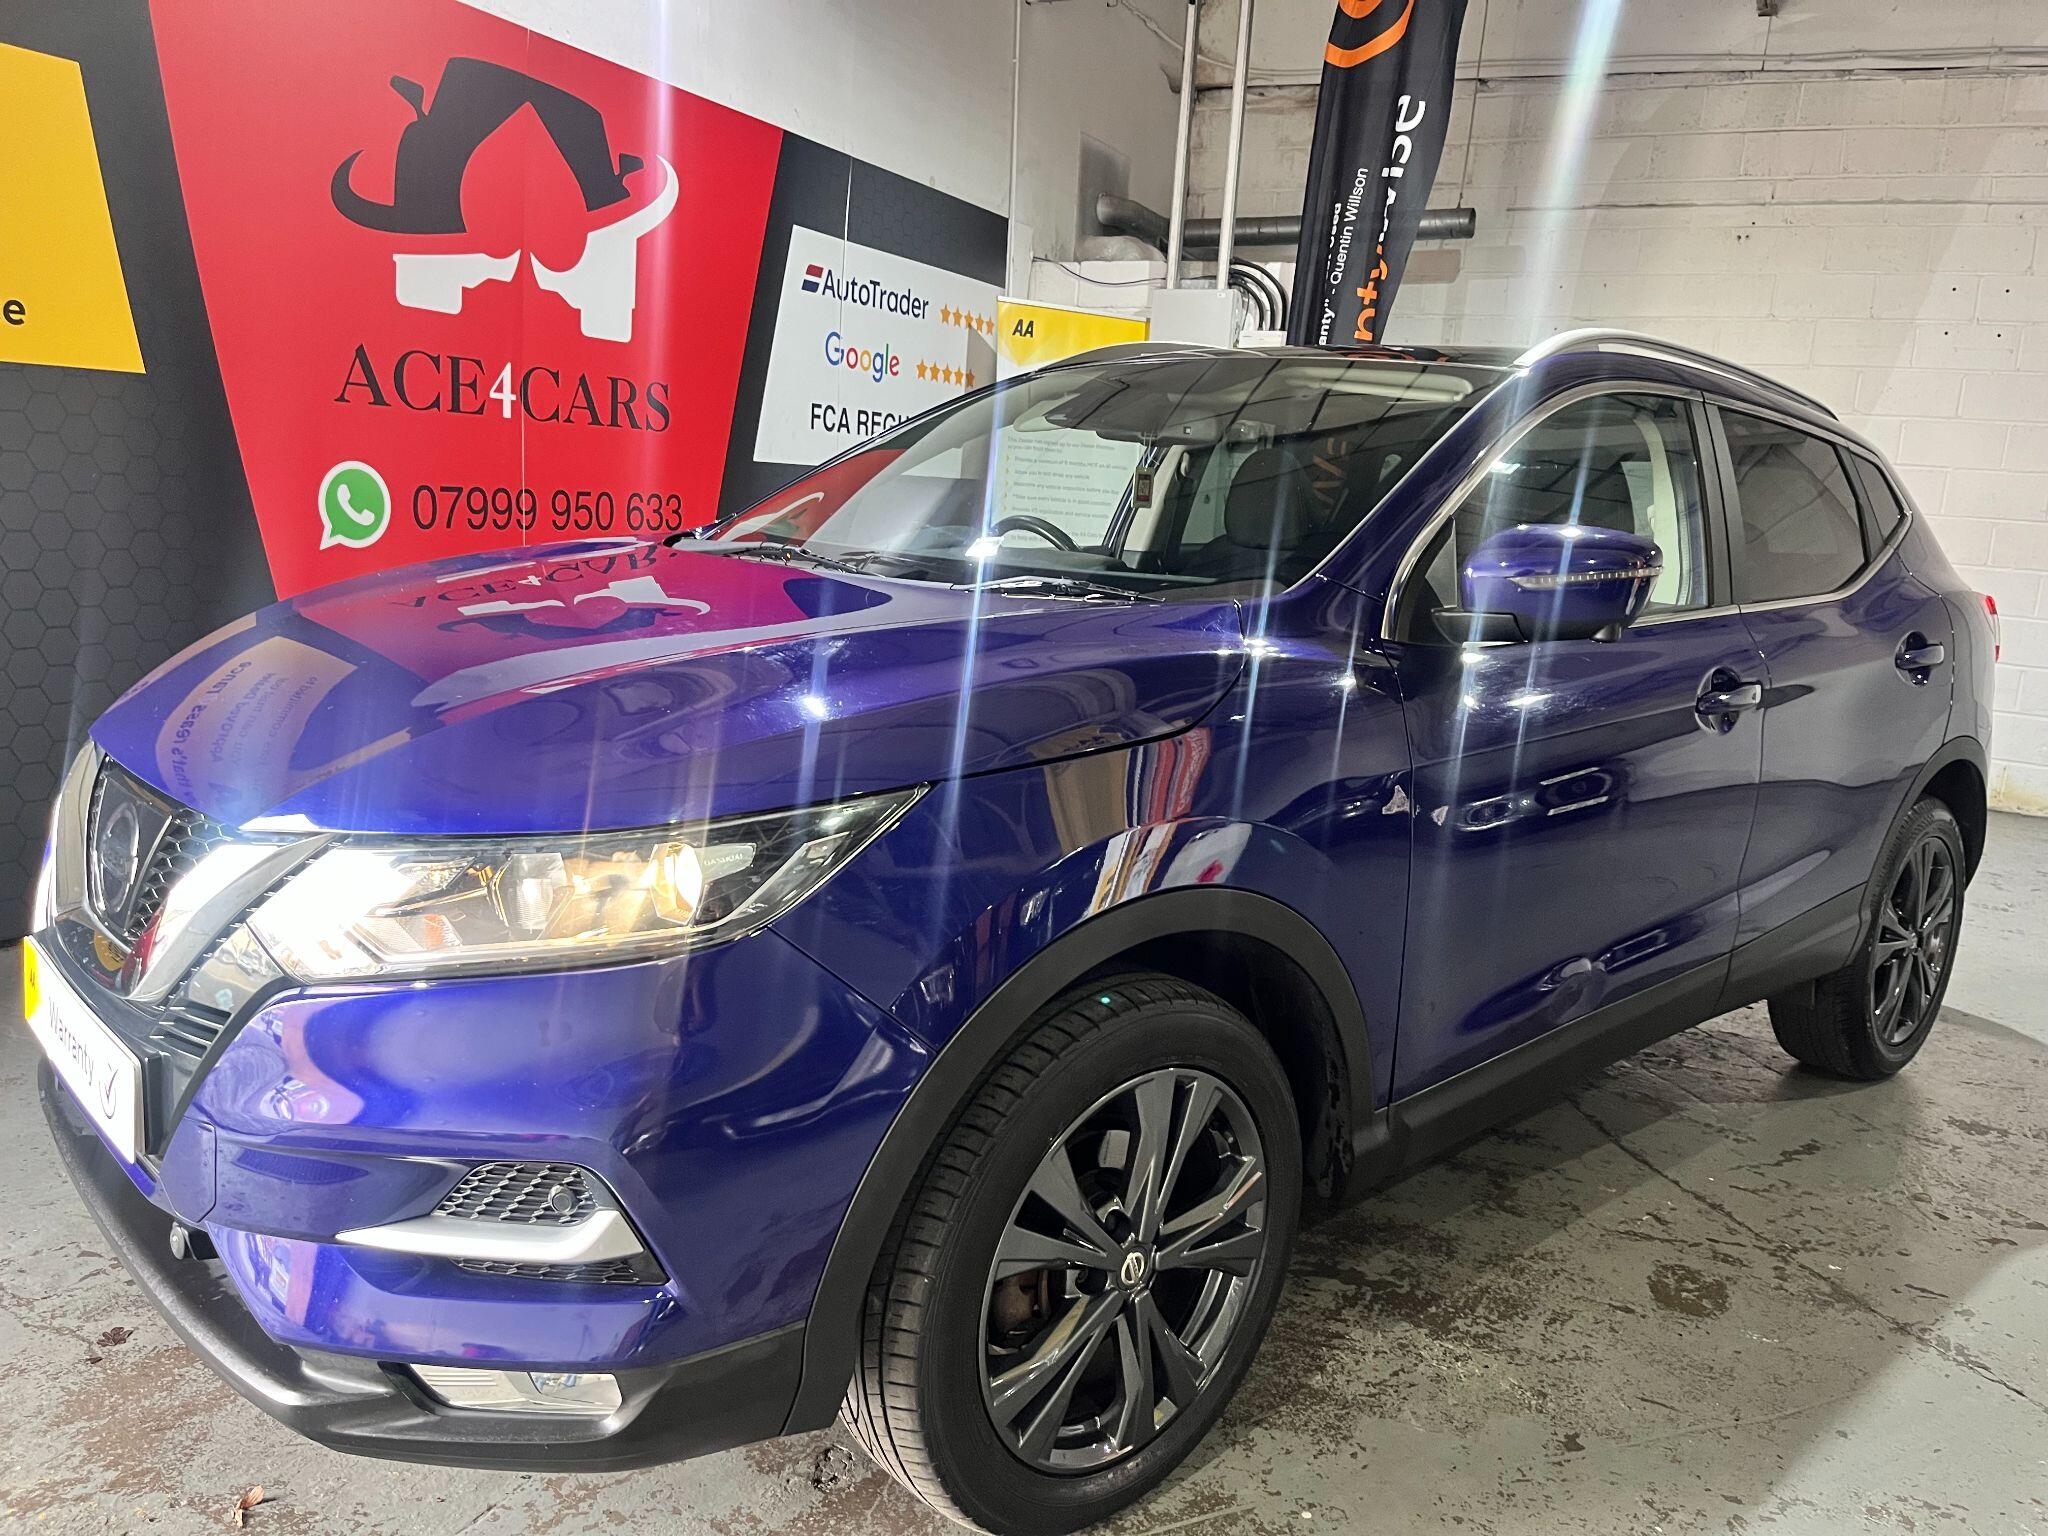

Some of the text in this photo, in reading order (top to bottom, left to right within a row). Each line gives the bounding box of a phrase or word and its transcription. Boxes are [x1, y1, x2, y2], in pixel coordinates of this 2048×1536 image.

[1330, 226, 1353, 285] Quentin
[1344, 167, 1369, 222] Willson
[822, 269, 929, 319] AutoTrader
[1012, 318, 1034, 338] AA
[825, 331, 900, 383] Google
[334, 342, 670, 432] ACE4CARS
[810, 402, 850, 434] FCA
[412, 484, 683, 532] 07999 950 633
[49, 996, 94, 1086] Warranty
